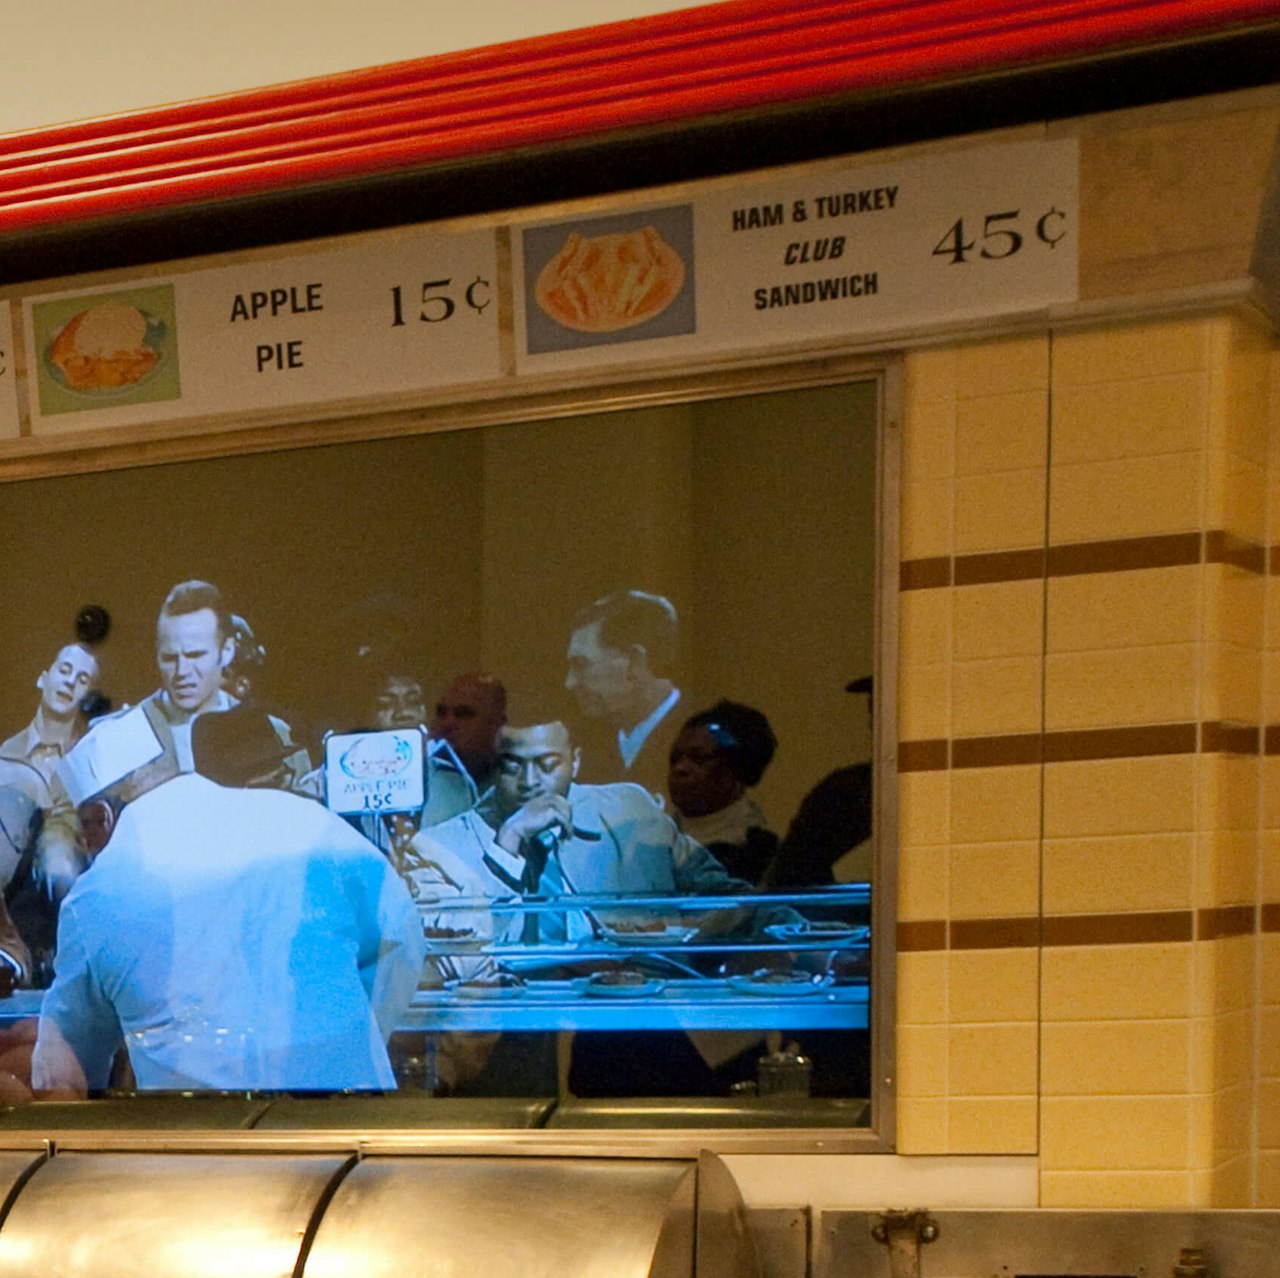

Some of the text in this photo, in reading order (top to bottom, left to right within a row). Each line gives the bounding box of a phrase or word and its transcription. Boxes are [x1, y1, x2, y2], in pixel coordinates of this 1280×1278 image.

[732, 185, 899, 232] HAM & TURKEY
[784, 235, 846, 266] CLUB
[932, 206, 1066, 265] 45¢
[230, 283, 323, 322] APPLE
[389, 276, 490, 327] 15¢
[754, 272, 878, 310] SANDWICH
[256, 340, 304, 372] PIE
